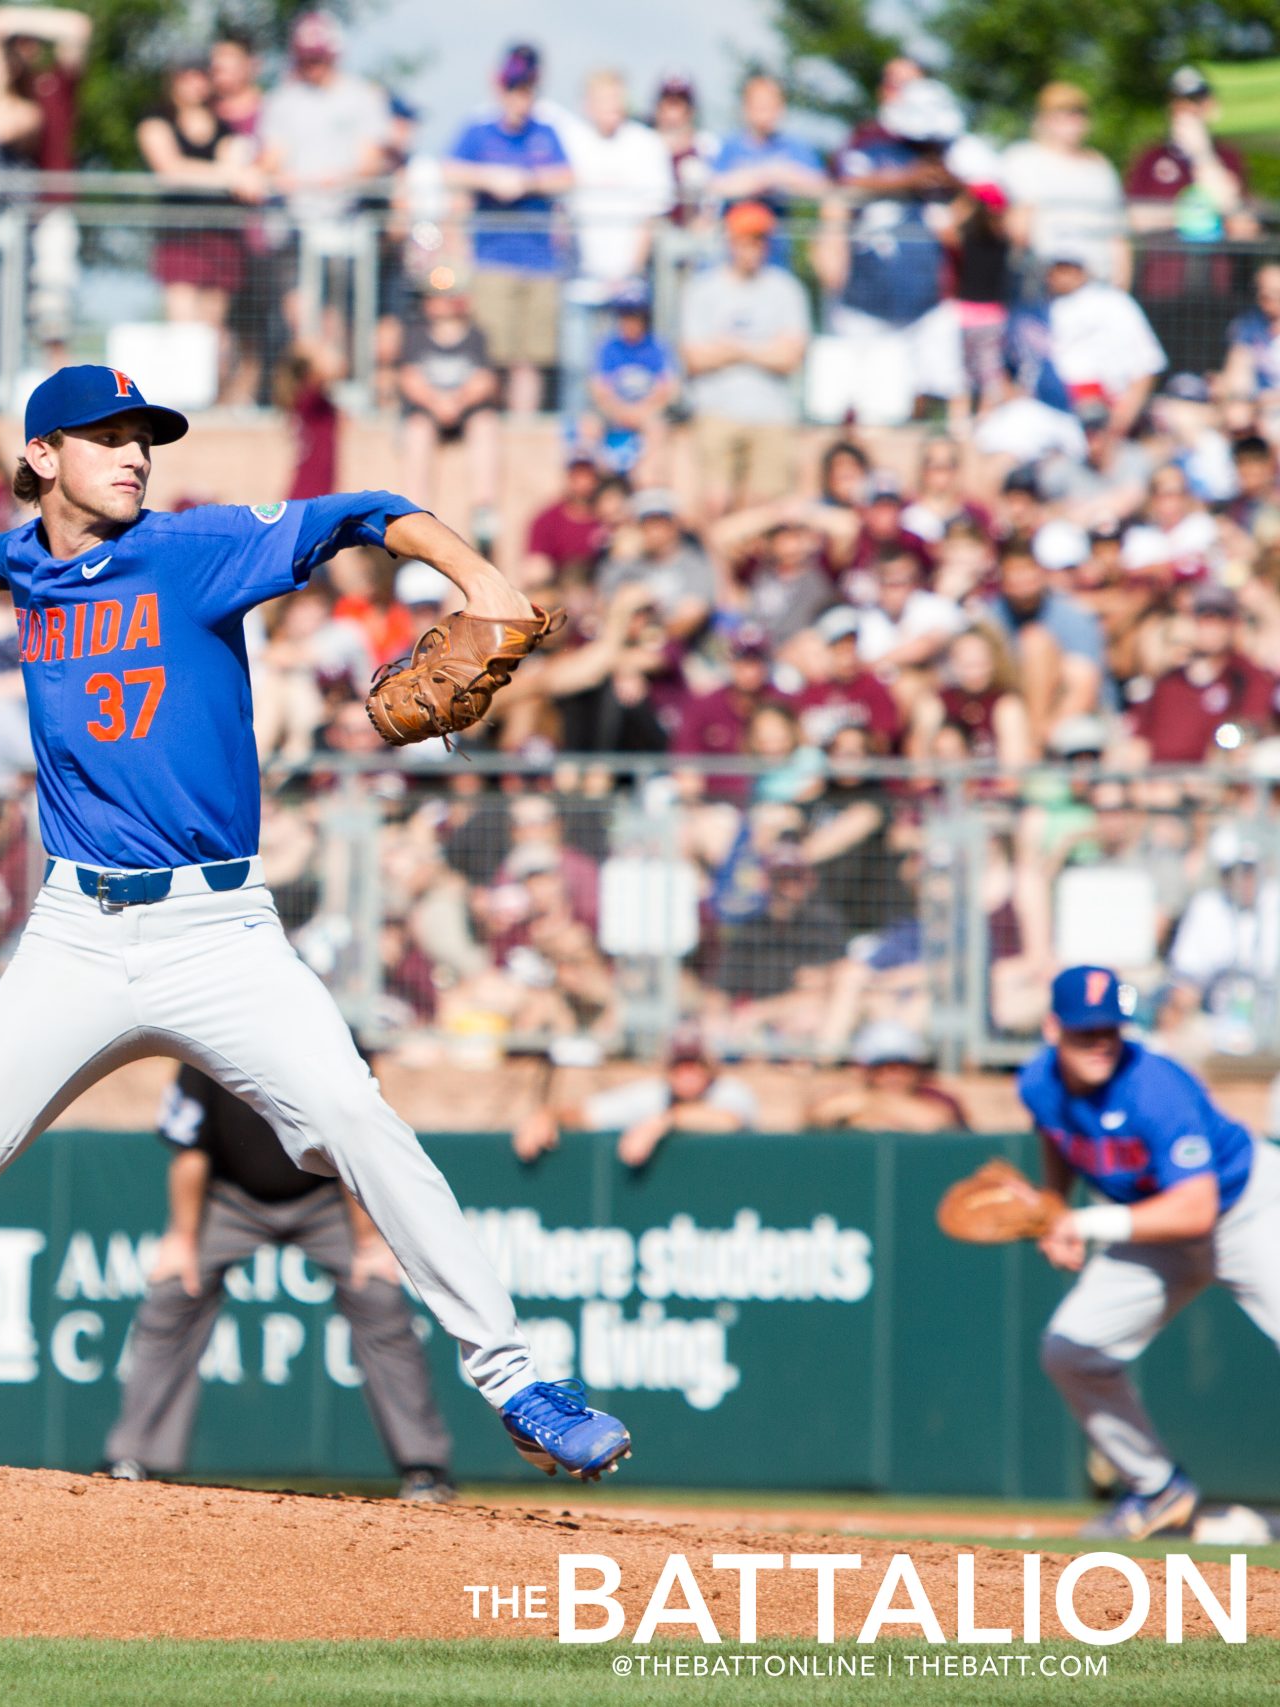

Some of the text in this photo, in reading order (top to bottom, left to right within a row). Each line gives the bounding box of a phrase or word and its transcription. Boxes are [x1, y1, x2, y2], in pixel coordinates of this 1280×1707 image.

[109, 369, 134, 397] F
[14, 592, 161, 663] LORIDA
[85, 666, 166, 742] 37
[639, 1208, 873, 1302] students
